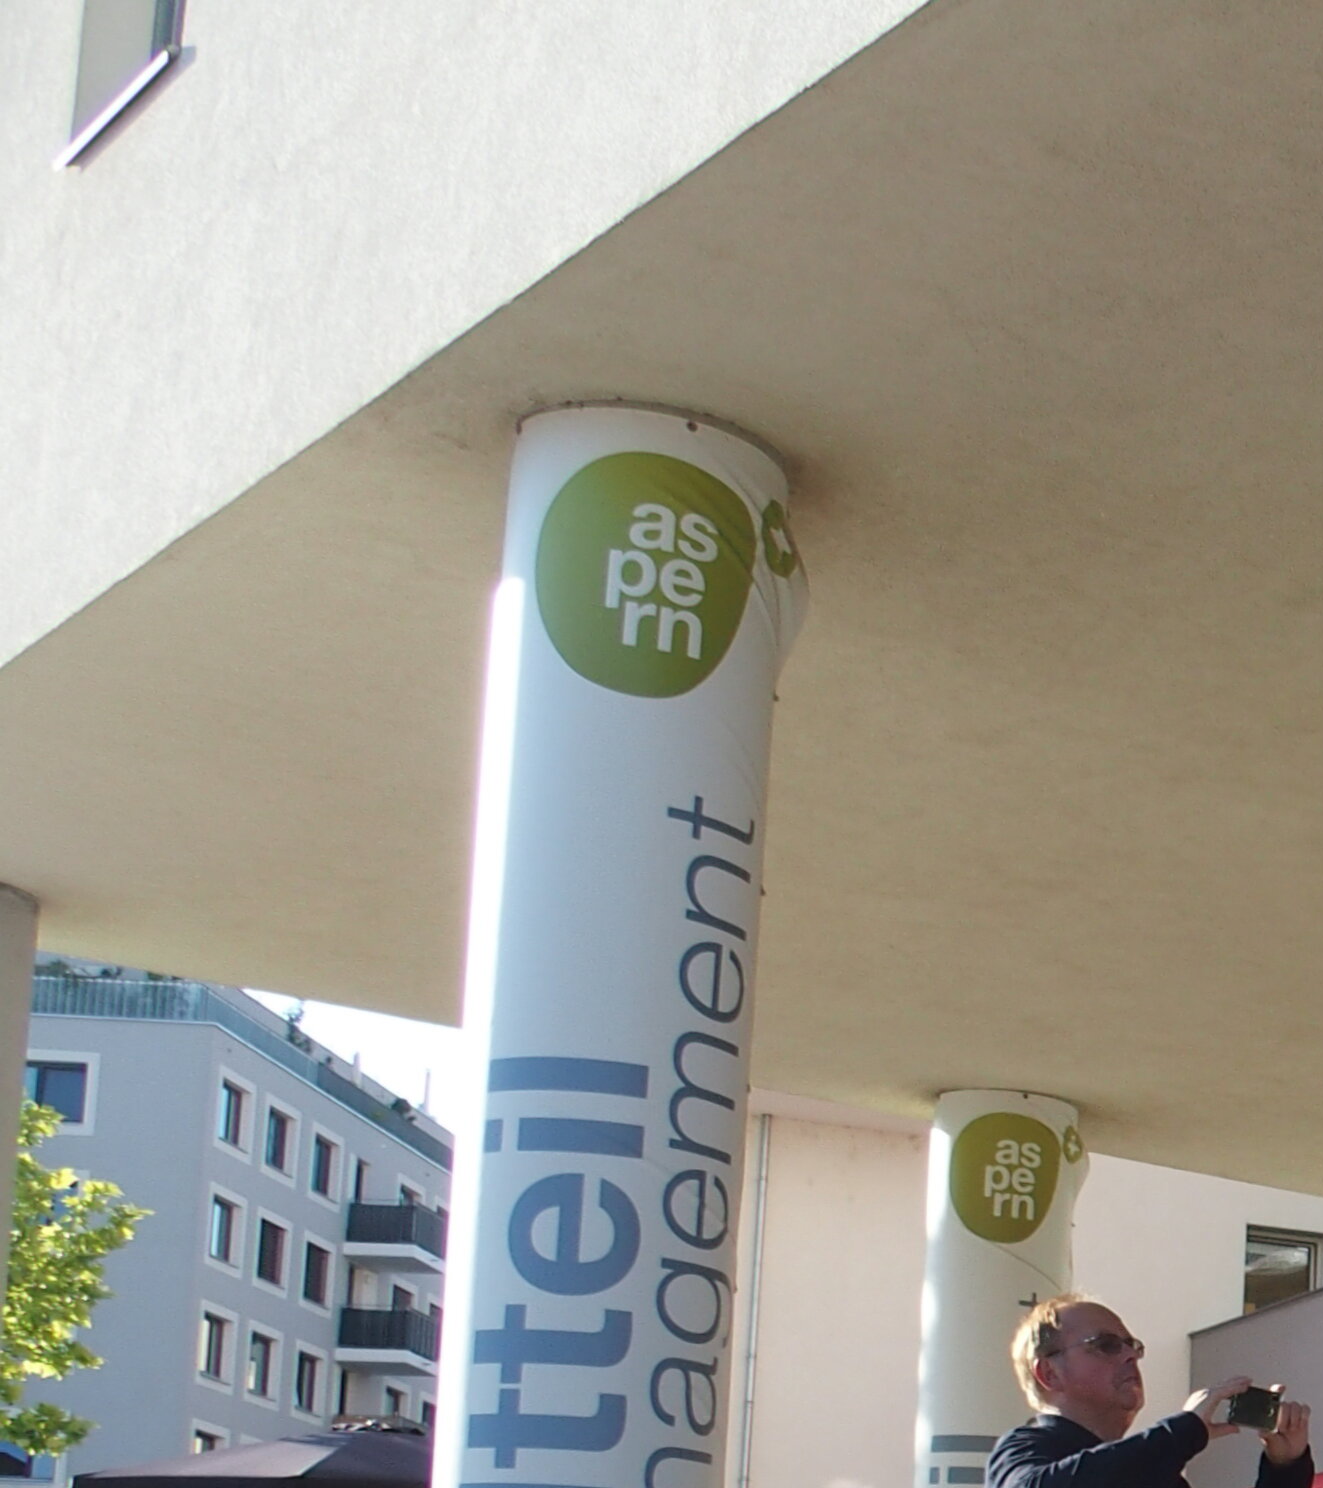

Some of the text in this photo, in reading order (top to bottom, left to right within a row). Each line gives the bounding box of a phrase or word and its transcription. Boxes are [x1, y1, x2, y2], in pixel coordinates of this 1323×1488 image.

[629, 502, 719, 562] as
[605, 547, 707, 608] pe
[620, 598, 704, 660] rn
[995, 1138, 1042, 1168] as
[984, 1165, 1037, 1197] pe
[993, 1193, 1036, 1221] rn
